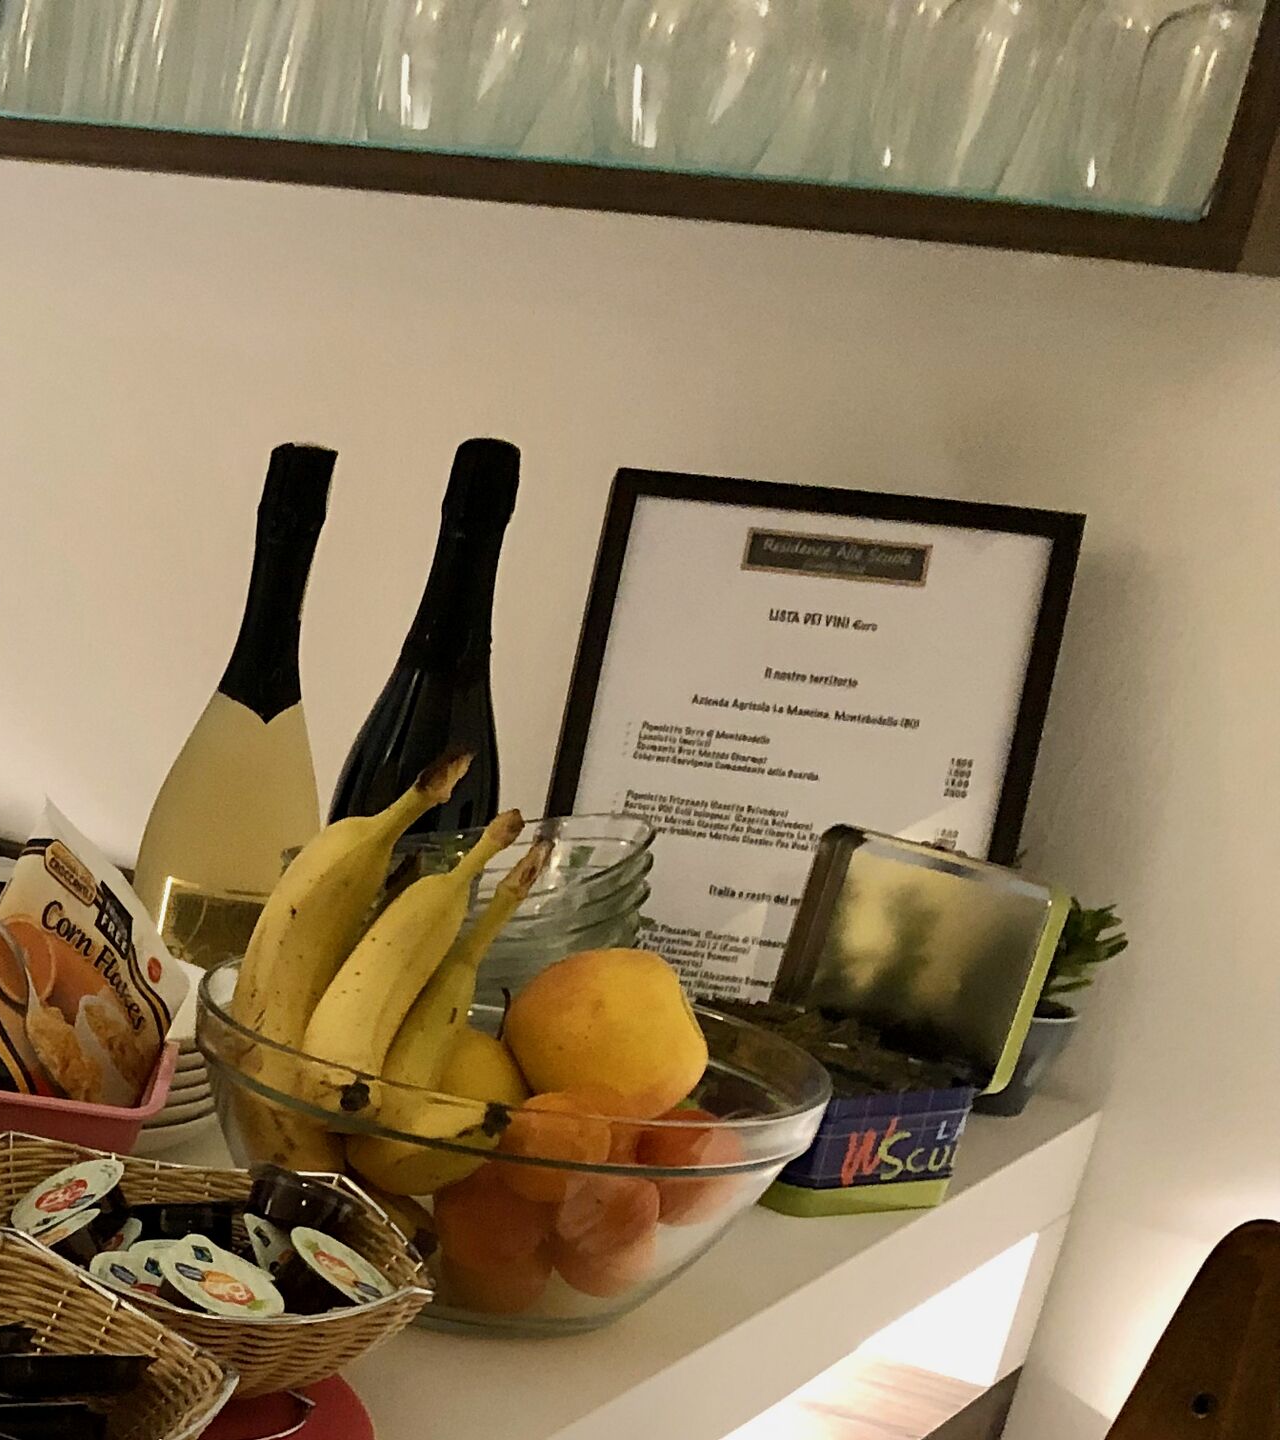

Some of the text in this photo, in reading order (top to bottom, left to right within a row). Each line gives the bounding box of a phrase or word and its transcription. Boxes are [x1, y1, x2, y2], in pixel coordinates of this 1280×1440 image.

[768, 608, 799, 624] LISTA
[803, 612, 823, 626] DEI
[825, 615, 850, 630] VINI
[773, 669, 808, 683] nostro
[809, 673, 859, 689] territorio
[691, 693, 730, 709] Azienda
[731, 698, 771, 713] Agricola
[100, 912, 130, 956] FREE
[41, 900, 93, 958] Corn
[93, 943, 145, 1031] Flakes
